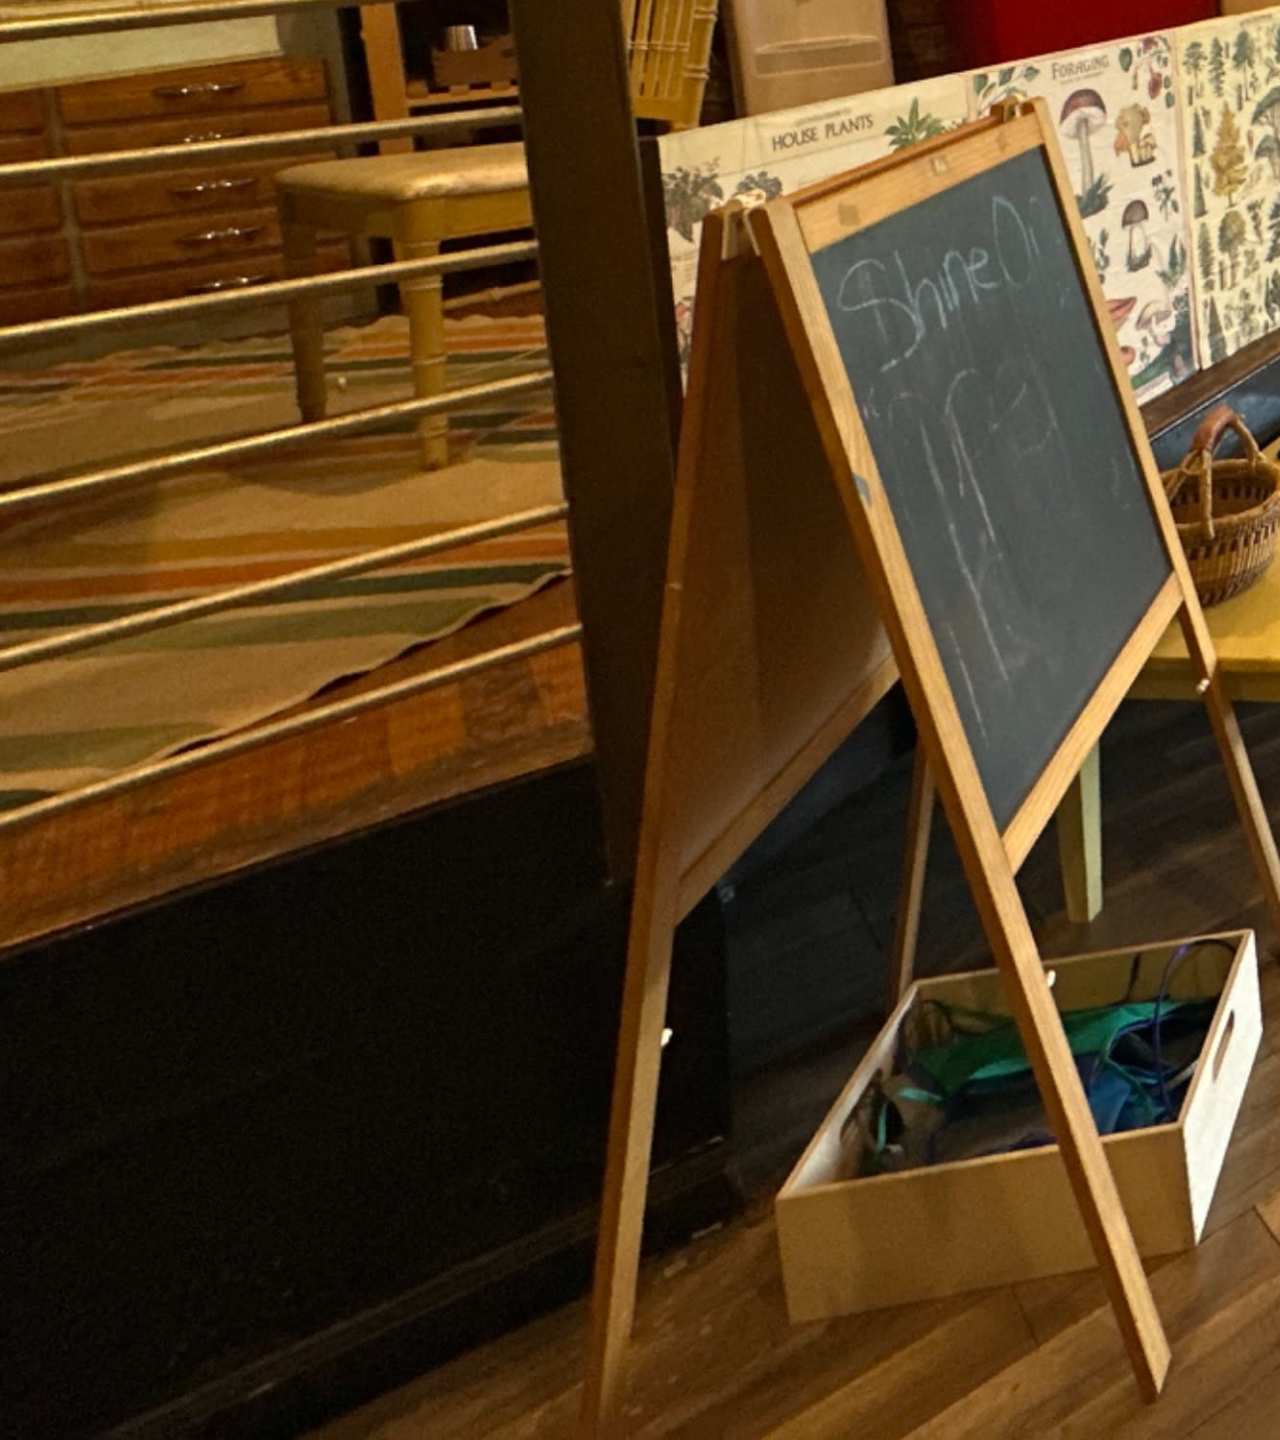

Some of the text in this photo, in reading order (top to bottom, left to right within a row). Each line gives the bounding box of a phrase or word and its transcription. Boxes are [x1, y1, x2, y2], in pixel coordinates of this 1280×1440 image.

[771, 127, 820, 152] HOUSE
[825, 114, 874, 140] PLANTS
[836, 246, 1001, 373] Shine
